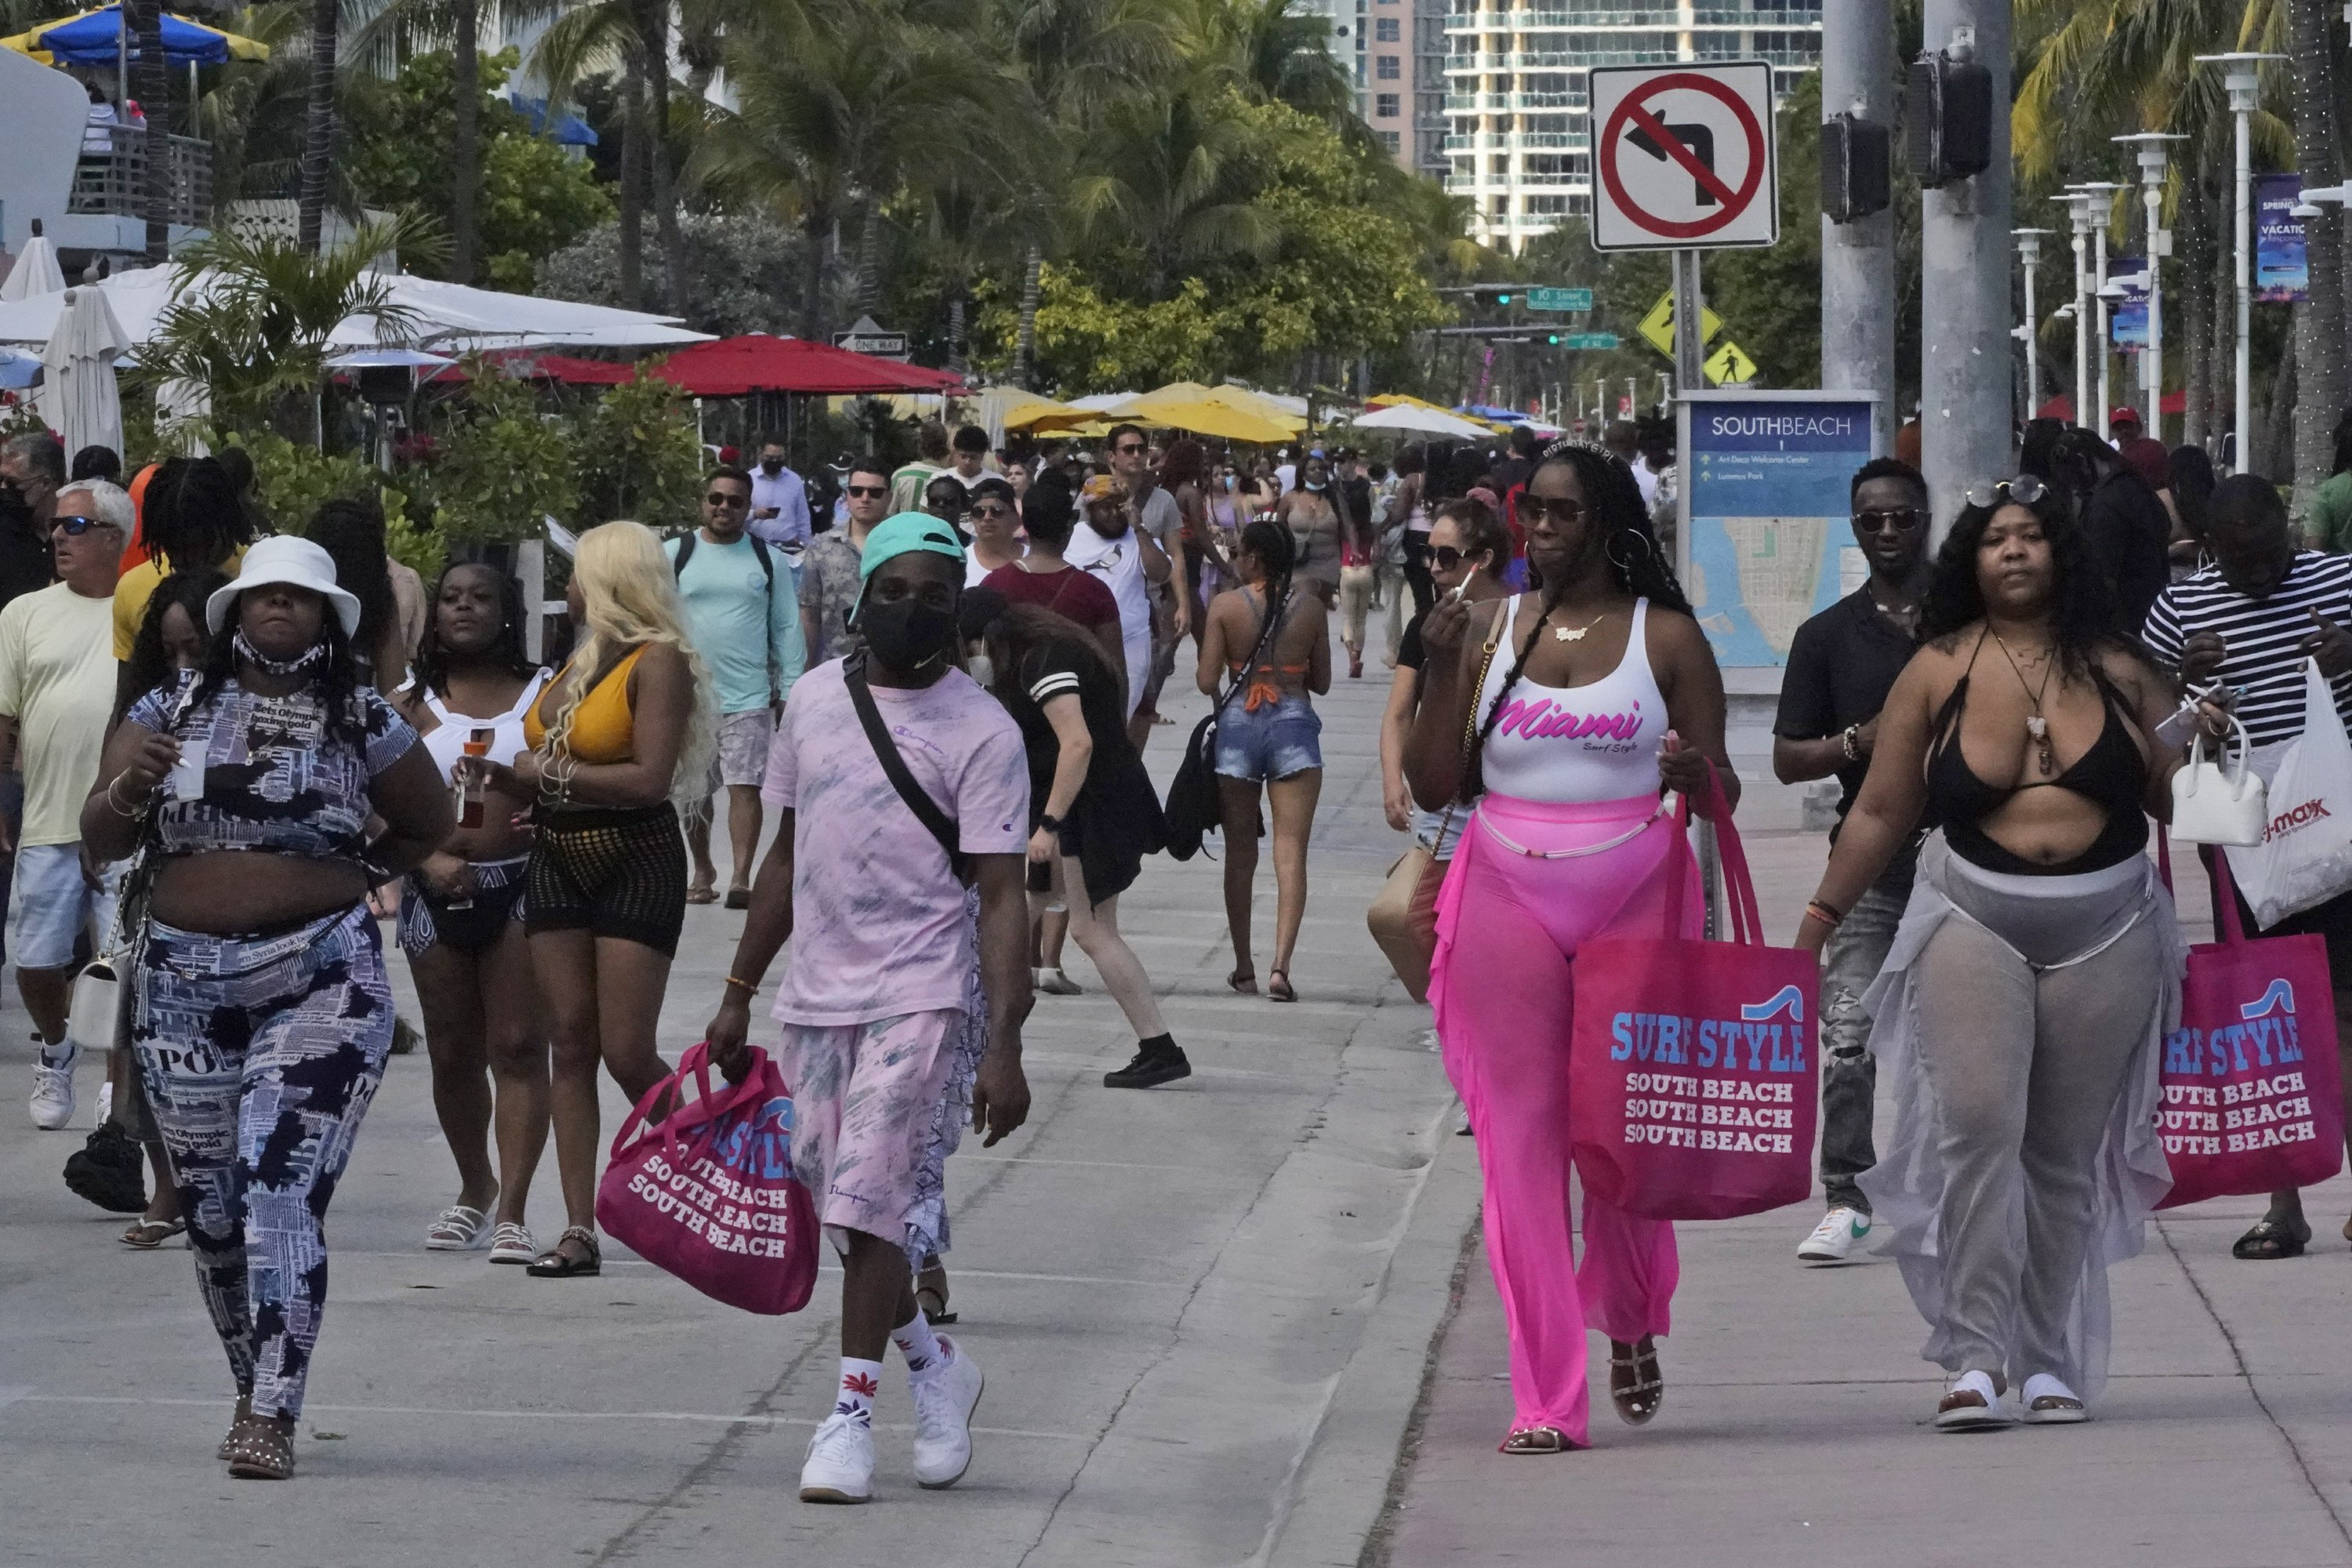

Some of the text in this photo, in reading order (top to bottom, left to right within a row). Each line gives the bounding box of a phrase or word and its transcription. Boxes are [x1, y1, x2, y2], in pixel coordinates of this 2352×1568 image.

[855, 339, 899, 350] ONE WAY
[1731, 455, 1749, 463] Deco
[1751, 455, 1784, 463] Welcome
[1786, 455, 1809, 463] Center
[287, 720, 311, 729] gold
[1494, 695, 1643, 741] Miami
[1611, 1011, 1806, 1073] SURF STYLE
[2210, 1016, 2303, 1076] STYLE
[1626, 1073, 1793, 1103] SOUTH BEACH
[2222, 1072, 2307, 1105] BEACH
[1624, 1098, 1793, 1129] SOUTH BEACH
[2225, 1097, 2312, 1130] BEACH
[191, 1138, 223, 1150] gold
[1624, 1123, 1793, 1154] SOUTH BEACH
[2159, 1121, 2316, 1156] UTH BEACH
[642, 1155, 788, 1234] SOUTH EACH
[628, 1174, 786, 1258] SOUTH BEACH
